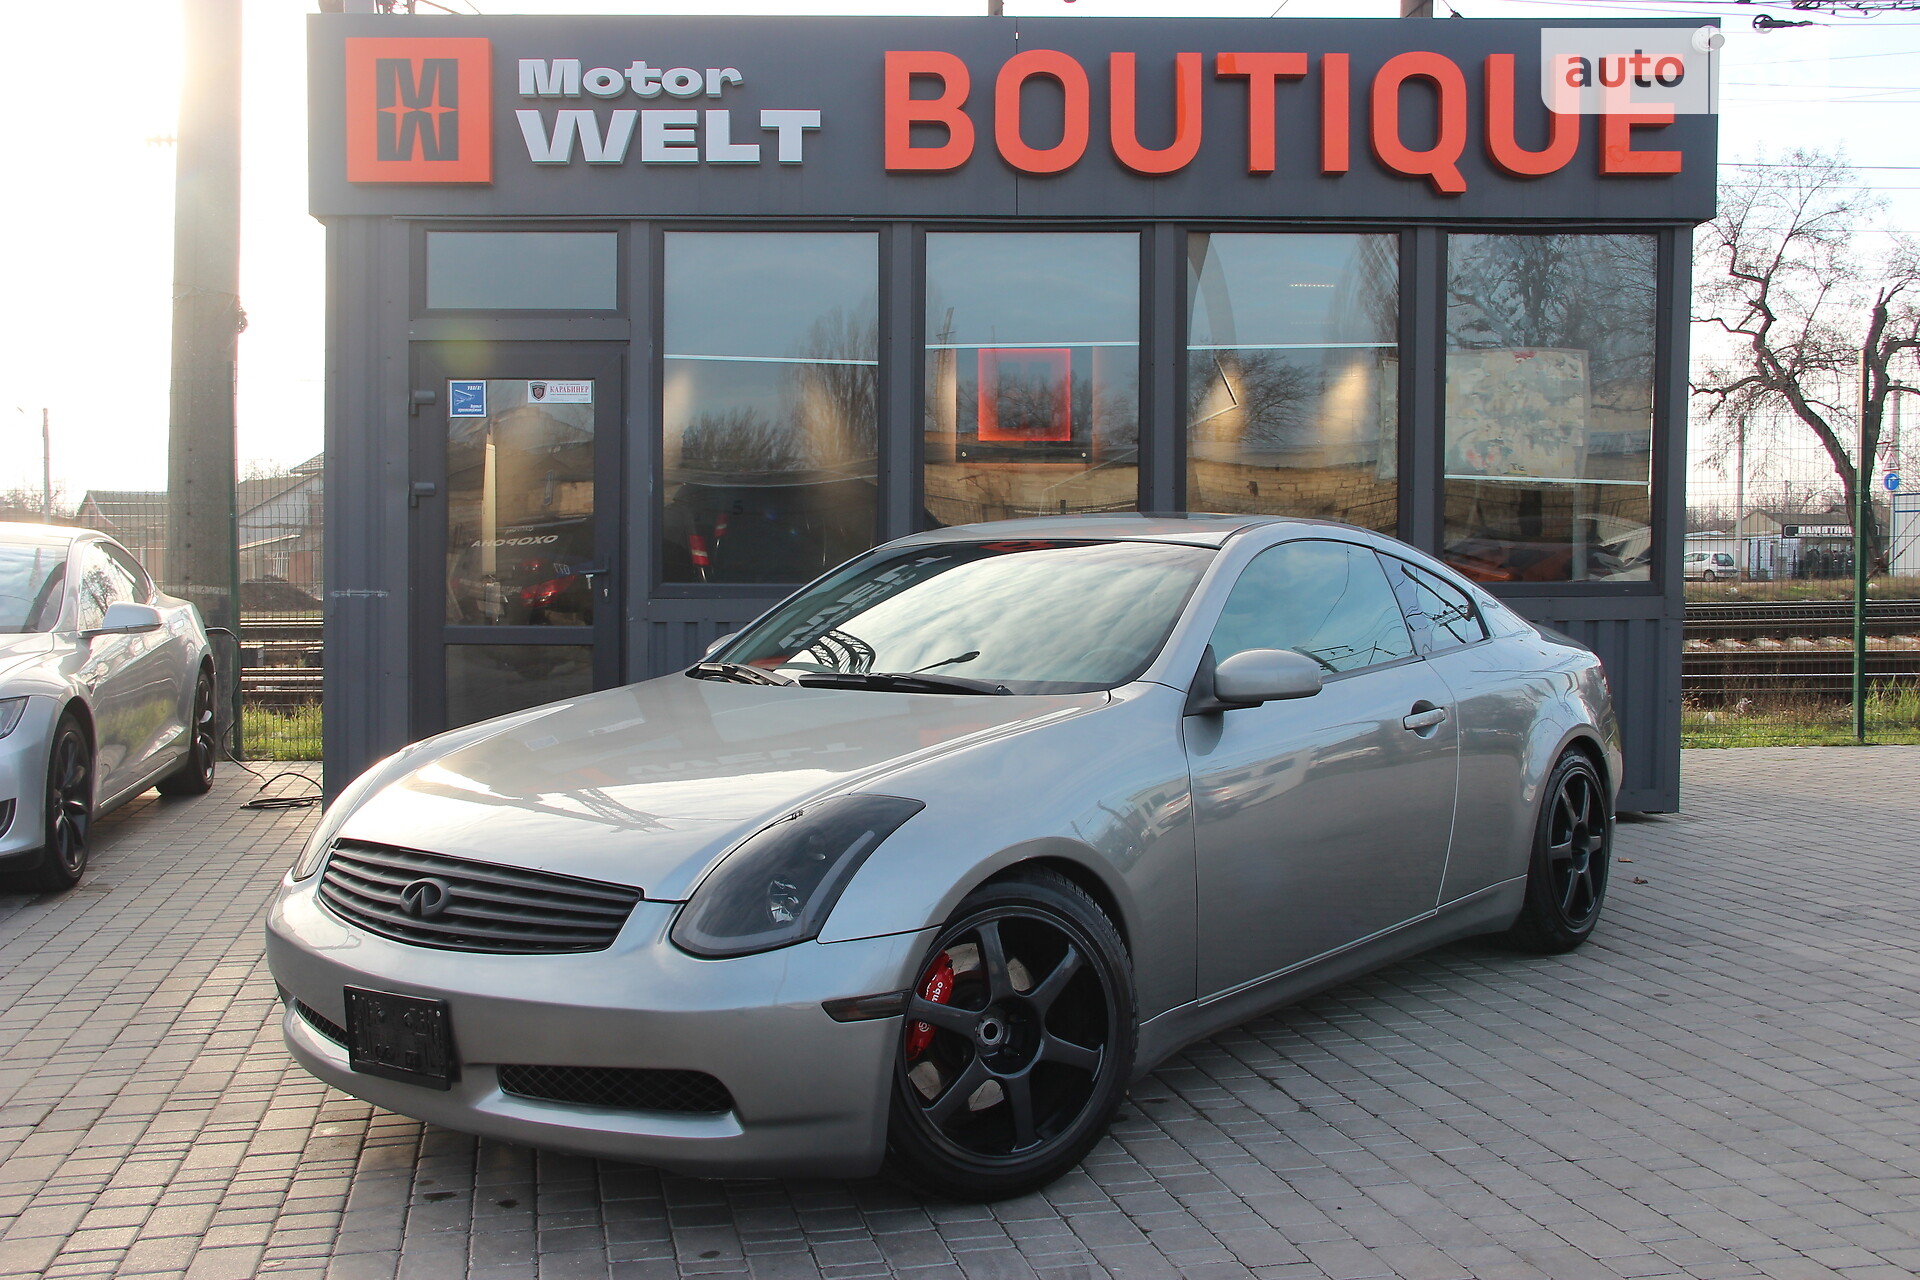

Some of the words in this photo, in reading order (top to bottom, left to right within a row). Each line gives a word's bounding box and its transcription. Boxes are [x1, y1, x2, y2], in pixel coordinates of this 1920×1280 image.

[518, 58, 743, 98] Motor
[515, 109, 821, 164] WELT
[883, 49, 1683, 194] BOUTIQUE
